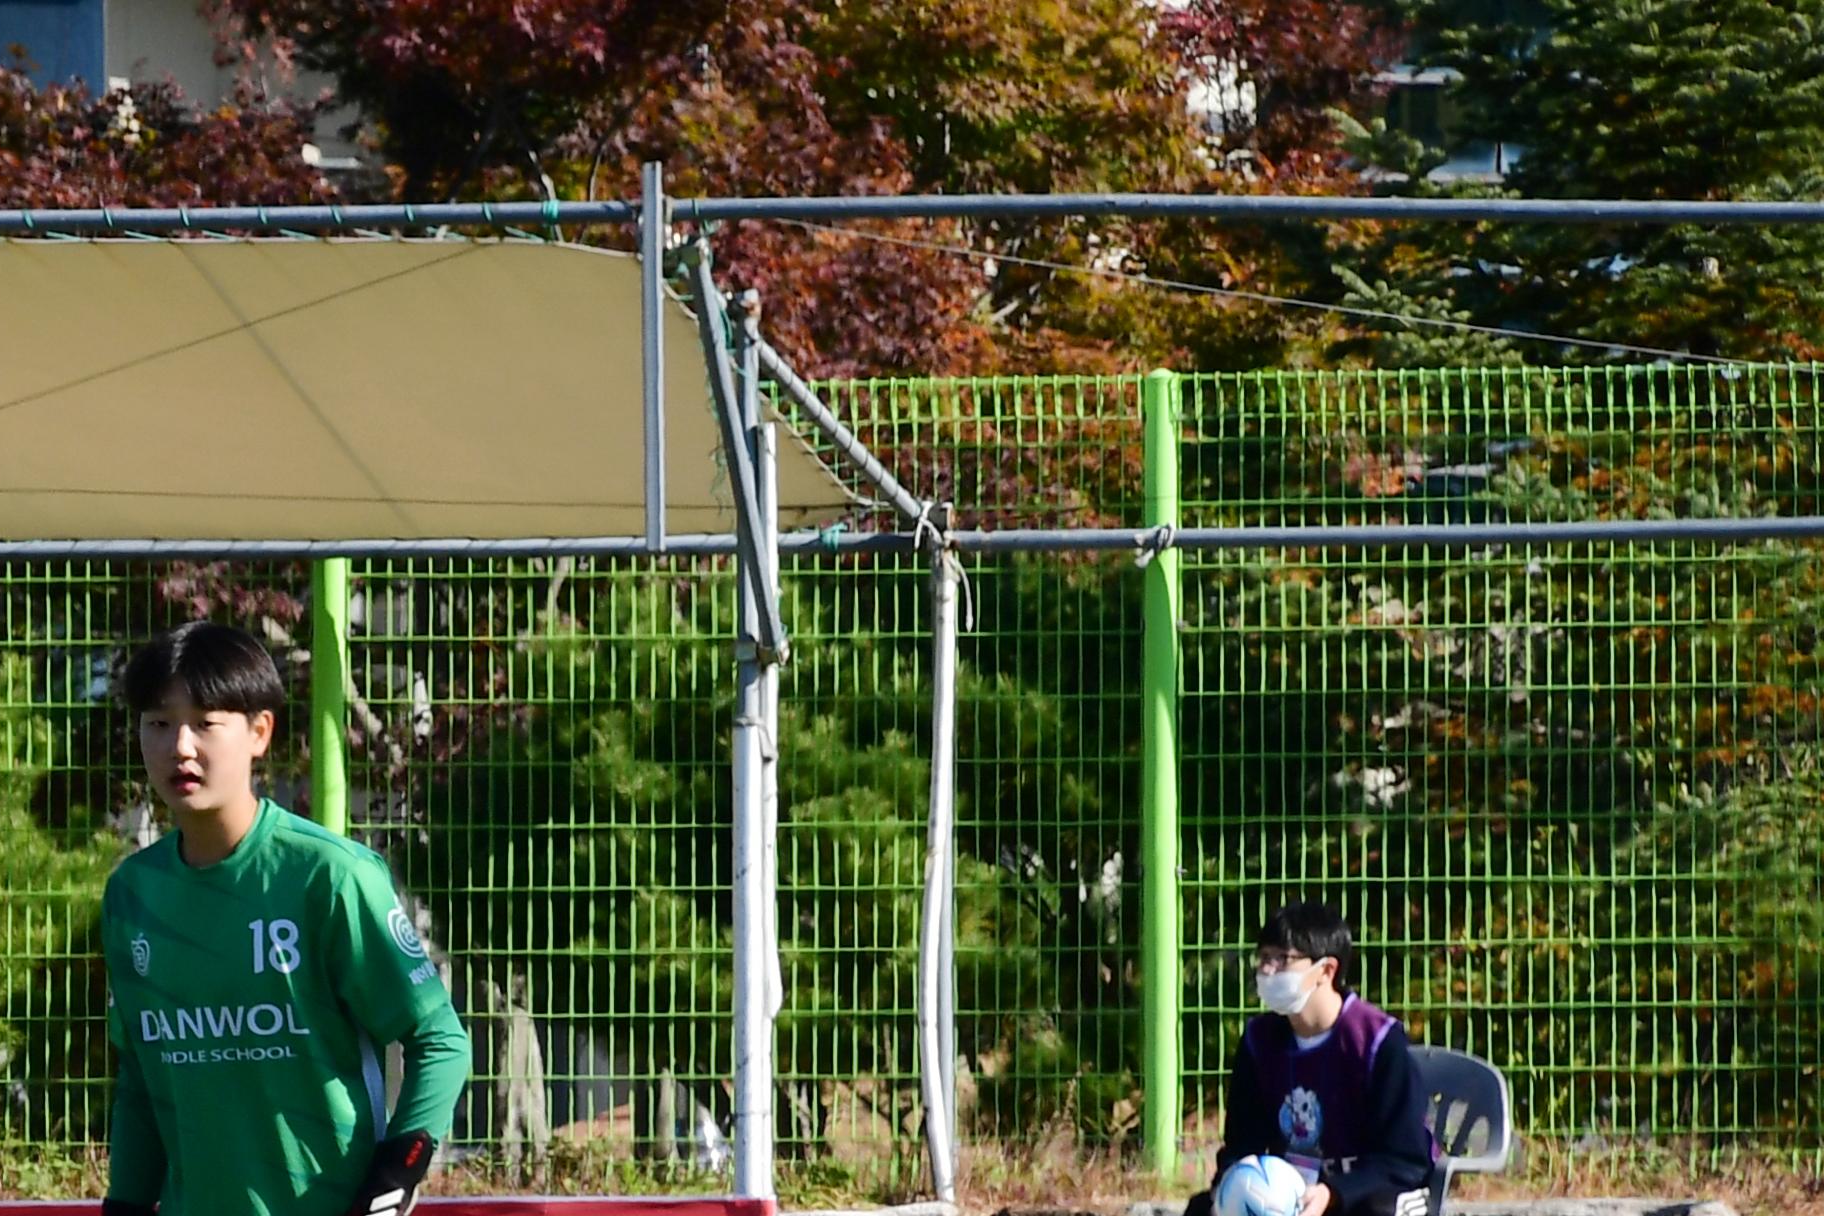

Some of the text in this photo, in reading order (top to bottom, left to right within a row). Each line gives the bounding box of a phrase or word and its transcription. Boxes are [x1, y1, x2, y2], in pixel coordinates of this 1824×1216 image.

[249, 919, 301, 974] 18
[141, 1003, 311, 1042] DANWOL
[211, 1046, 297, 1063] SCHOOL
